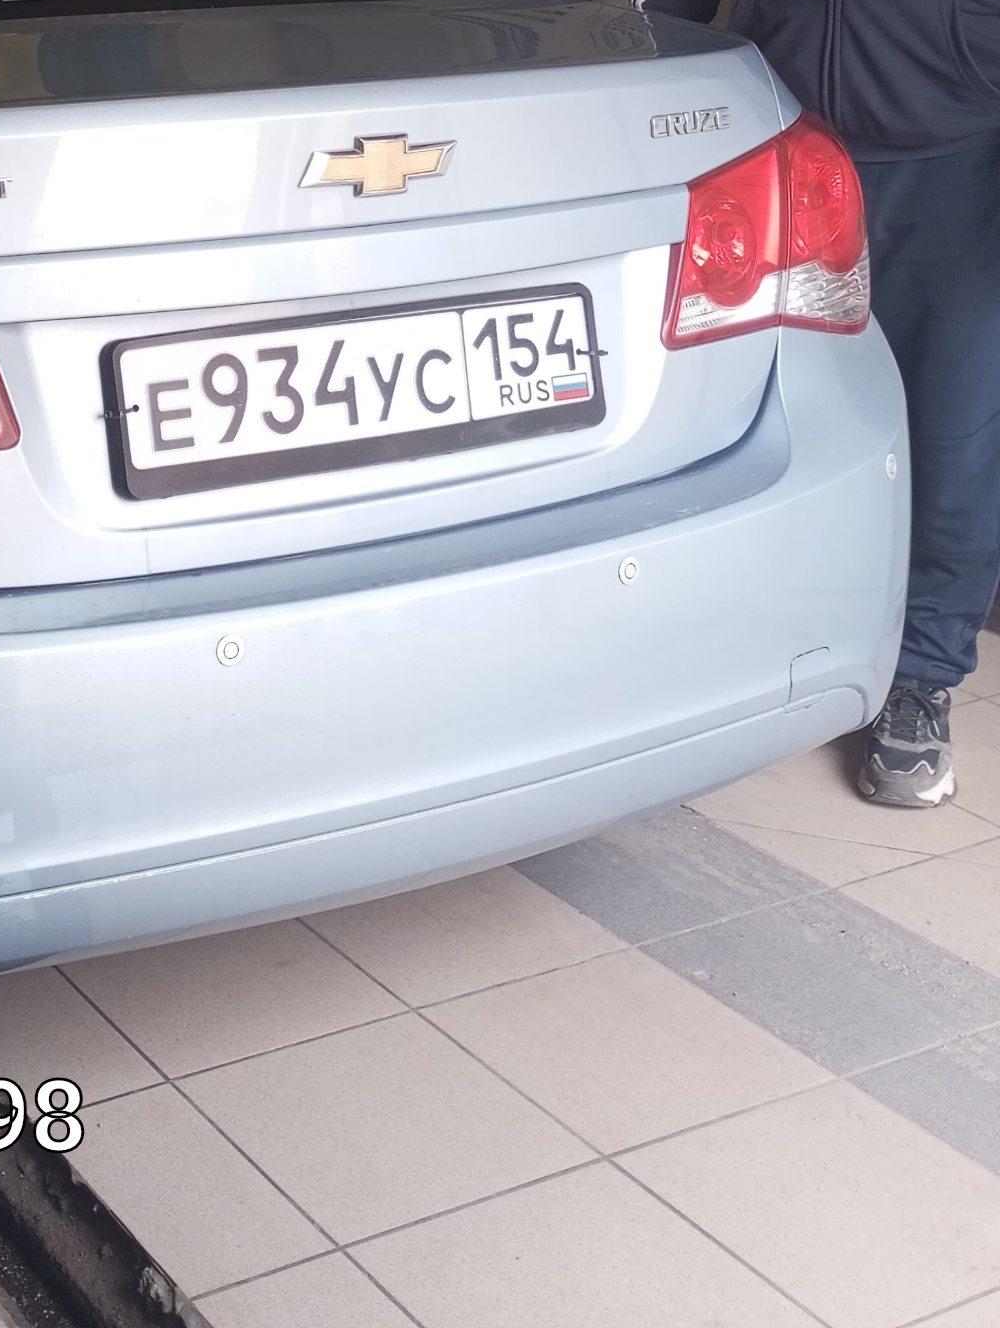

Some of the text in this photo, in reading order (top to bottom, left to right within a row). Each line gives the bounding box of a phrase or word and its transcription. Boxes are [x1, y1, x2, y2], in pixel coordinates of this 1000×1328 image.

[649, 106, 730, 139] CRUZE
[473, 309, 576, 381] 154
[500, 379, 551, 407] RUS
